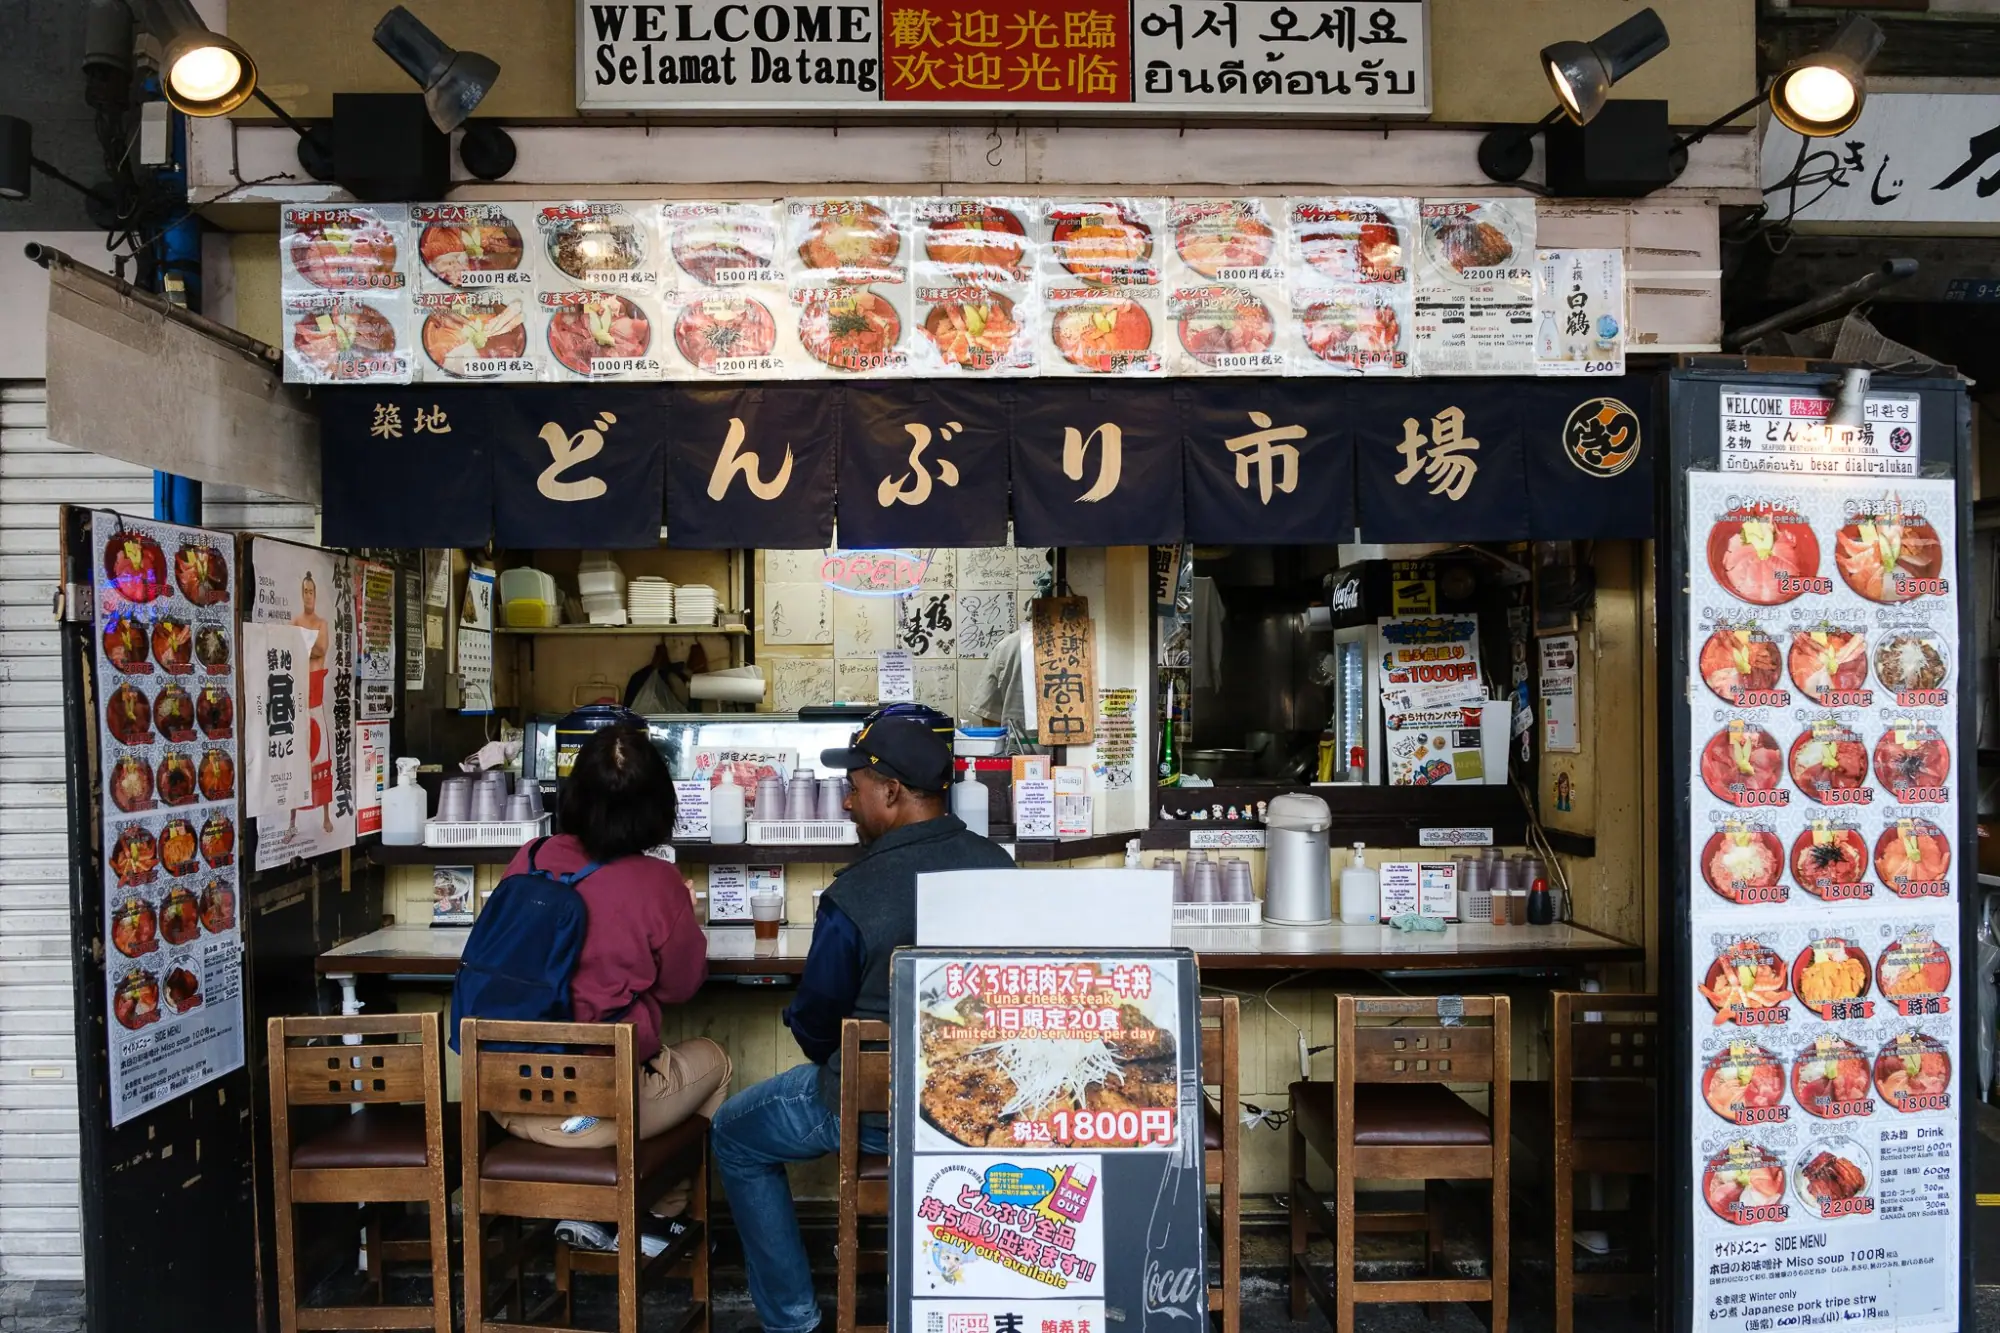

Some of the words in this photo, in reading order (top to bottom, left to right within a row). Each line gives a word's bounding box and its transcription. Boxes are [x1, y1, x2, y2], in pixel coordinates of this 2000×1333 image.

[590, 4, 872, 42] WELCOME
[889, 9, 1116, 50] 歡迎光臨
[1141, 2, 1237, 50] 어서
[1259, 6, 1408, 53] 오세요
[595, 43, 737, 86] Selamat
[751, 46, 878, 92] Datang
[891, 50, 1119, 94] 欢迎光临
[1145, 52, 1416, 96] ยินดีต้อนรับ
[346, 273, 406, 287] 2500円
[462, 272, 532, 285] 2000円税込
[716, 270, 785, 282] 1500円税込
[1217, 269, 1285, 280] 1800円税込
[1463, 268, 1532, 281] 2200円税込
[1566, 284, 1590, 336] 白鶴
[465, 360, 534, 373] 1800円税込
[591, 358, 660, 371] 1000円税込
[716, 358, 784, 371] 1200円税込
[1584, 361, 1614, 373] 600
[1726, 397, 1783, 416] WELCOME
[1866, 403, 1910, 420] 대환영
[1725, 418, 1752, 433] 築地
[1725, 436, 1753, 450] 名物
[1761, 443, 1787, 451] SEAFOOD
[370, 403, 453, 440] 築地
[536, 405, 1481, 508] どんぶり市場
[1810, 457, 1840, 472] besar
[1845, 457, 1912, 474] dialu-alukan
[1726, 495, 1801, 512] ①中トロ丼
[820, 557, 928, 587] OPEN
[1781, 578, 1833, 594] 2500円
[1898, 578, 1949, 594] 3500円
[1410, 662, 1478, 683] 1000円
[1738, 692, 1791, 706] 2000円
[1824, 692, 1873, 706] 1800円
[1900, 692, 1948, 706] 1800円
[369, 729, 384, 739] PayPay
[268, 738, 295, 758] はしご
[1739, 790, 1790, 804] 1000円
[1824, 789, 1873, 802] 1500円
[1901, 788, 1949, 802] 1200円
[1739, 888, 1790, 901] 1000円
[1824, 885, 1874, 898] 1800円
[1900, 882, 1950, 896] 2000円
[946, 963, 1152, 999] まぐろほほ肉ステーキ丼
[984, 991, 1019, 1006] Tuna
[1023, 991, 1067, 1005] cheek
[1070, 991, 1113, 1005] steak
[1907, 997, 1940, 1015] 特価
[984, 1008, 1121, 1031] 1日限定20食
[1738, 1009, 1790, 1024] 1500円
[1831, 1003, 1865, 1020] 特価
[943, 1026, 997, 1040] Limited
[1000, 1027, 1016, 1040] to
[1019, 1027, 1038, 1040] 20
[1041, 1026, 1101, 1043] servings
[1103, 1028, 1127, 1043] per
[1130, 1026, 1156, 1043] day
[139, 1078, 166, 1094] Japanese
[1825, 1101, 1875, 1116] 1800円
[1900, 1094, 1951, 1110] 1800円
[1738, 1107, 1790, 1122] 1800円
[1013, 1121, 1051, 1142] 税込
[1052, 1108, 1174, 1142] 1800円
[1880, 1129, 1908, 1142] 飲み物
[1917, 1127, 1944, 1138] Drink
[1923, 1166, 1950, 1176] 600円
[1058, 1186, 1088, 1206] TAKE
[1056, 1200, 1081, 1215] OUT
[1738, 1206, 1790, 1222] 1500円
[1823, 1198, 1875, 1214] 2200円
[956, 1183, 1076, 1251] どんぶり全品
[1880, 1212, 1906, 1220] CANADA
[918, 1195, 1098, 1283] 持ち帰り出来ます!!
[1714, 1240, 1768, 1258] サイドメニュー
[1774, 1236, 1797, 1252] SIDE
[1800, 1233, 1827, 1249] MENU
[932, 1226, 975, 1255] Carry
[974, 1244, 1002, 1264] out
[1003, 1256, 1068, 1290] available
[1709, 1258, 1783, 1275] 本日のお味噌汁
[1786, 1256, 1814, 1268] Miso
[1817, 1253, 1845, 1265] soup
[1850, 1247, 1885, 1262] 100円
[1146, 1260, 1197, 1304] Coca
[1749, 1291, 1777, 1302] Winter
[1779, 1289, 1798, 1299] only
[1709, 1306, 1738, 1320] もつ煮
[1741, 1303, 1794, 1316] Japanese
[1797, 1299, 1822, 1311] pork
[1825, 1296, 1851, 1308] tripe
